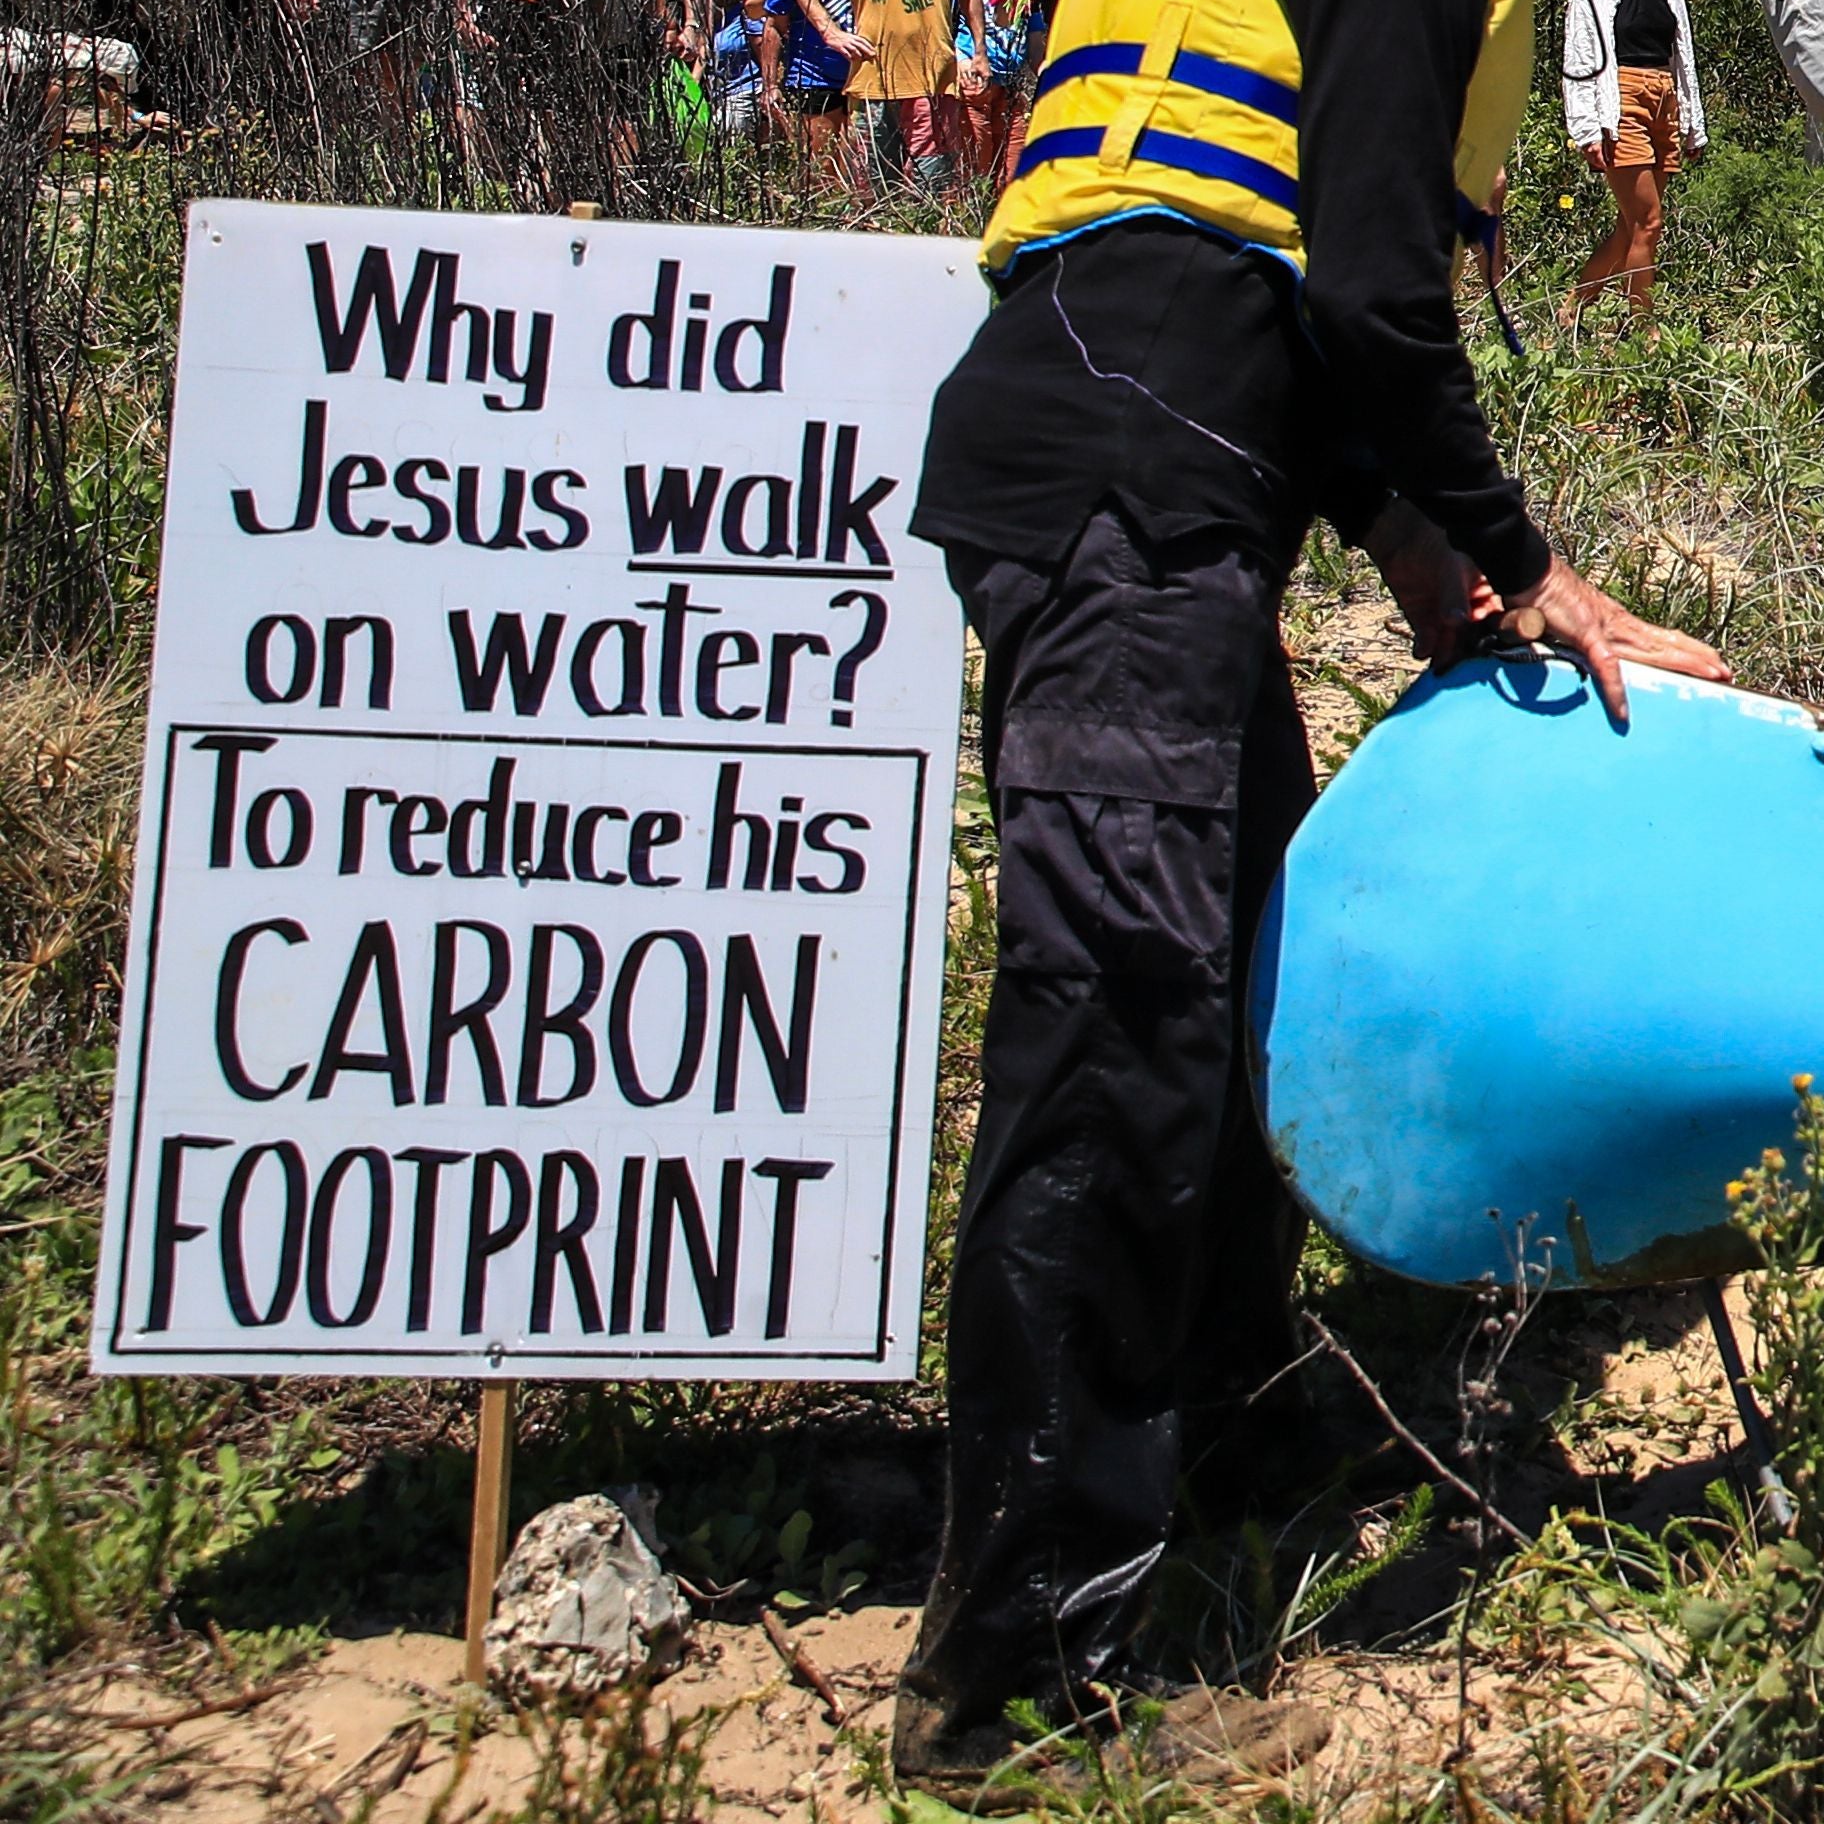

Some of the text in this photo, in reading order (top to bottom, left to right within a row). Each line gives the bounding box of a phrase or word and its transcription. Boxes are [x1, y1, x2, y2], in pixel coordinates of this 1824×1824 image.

[306, 242, 795, 412] Why did
[231, 395, 898, 566] Jesus walk
[246, 583, 886, 724] on water?
[191, 735, 870, 894] To reduce his
[215, 918, 820, 1114] CARBON
[144, 1134, 833, 1340] FOOTPRINT
